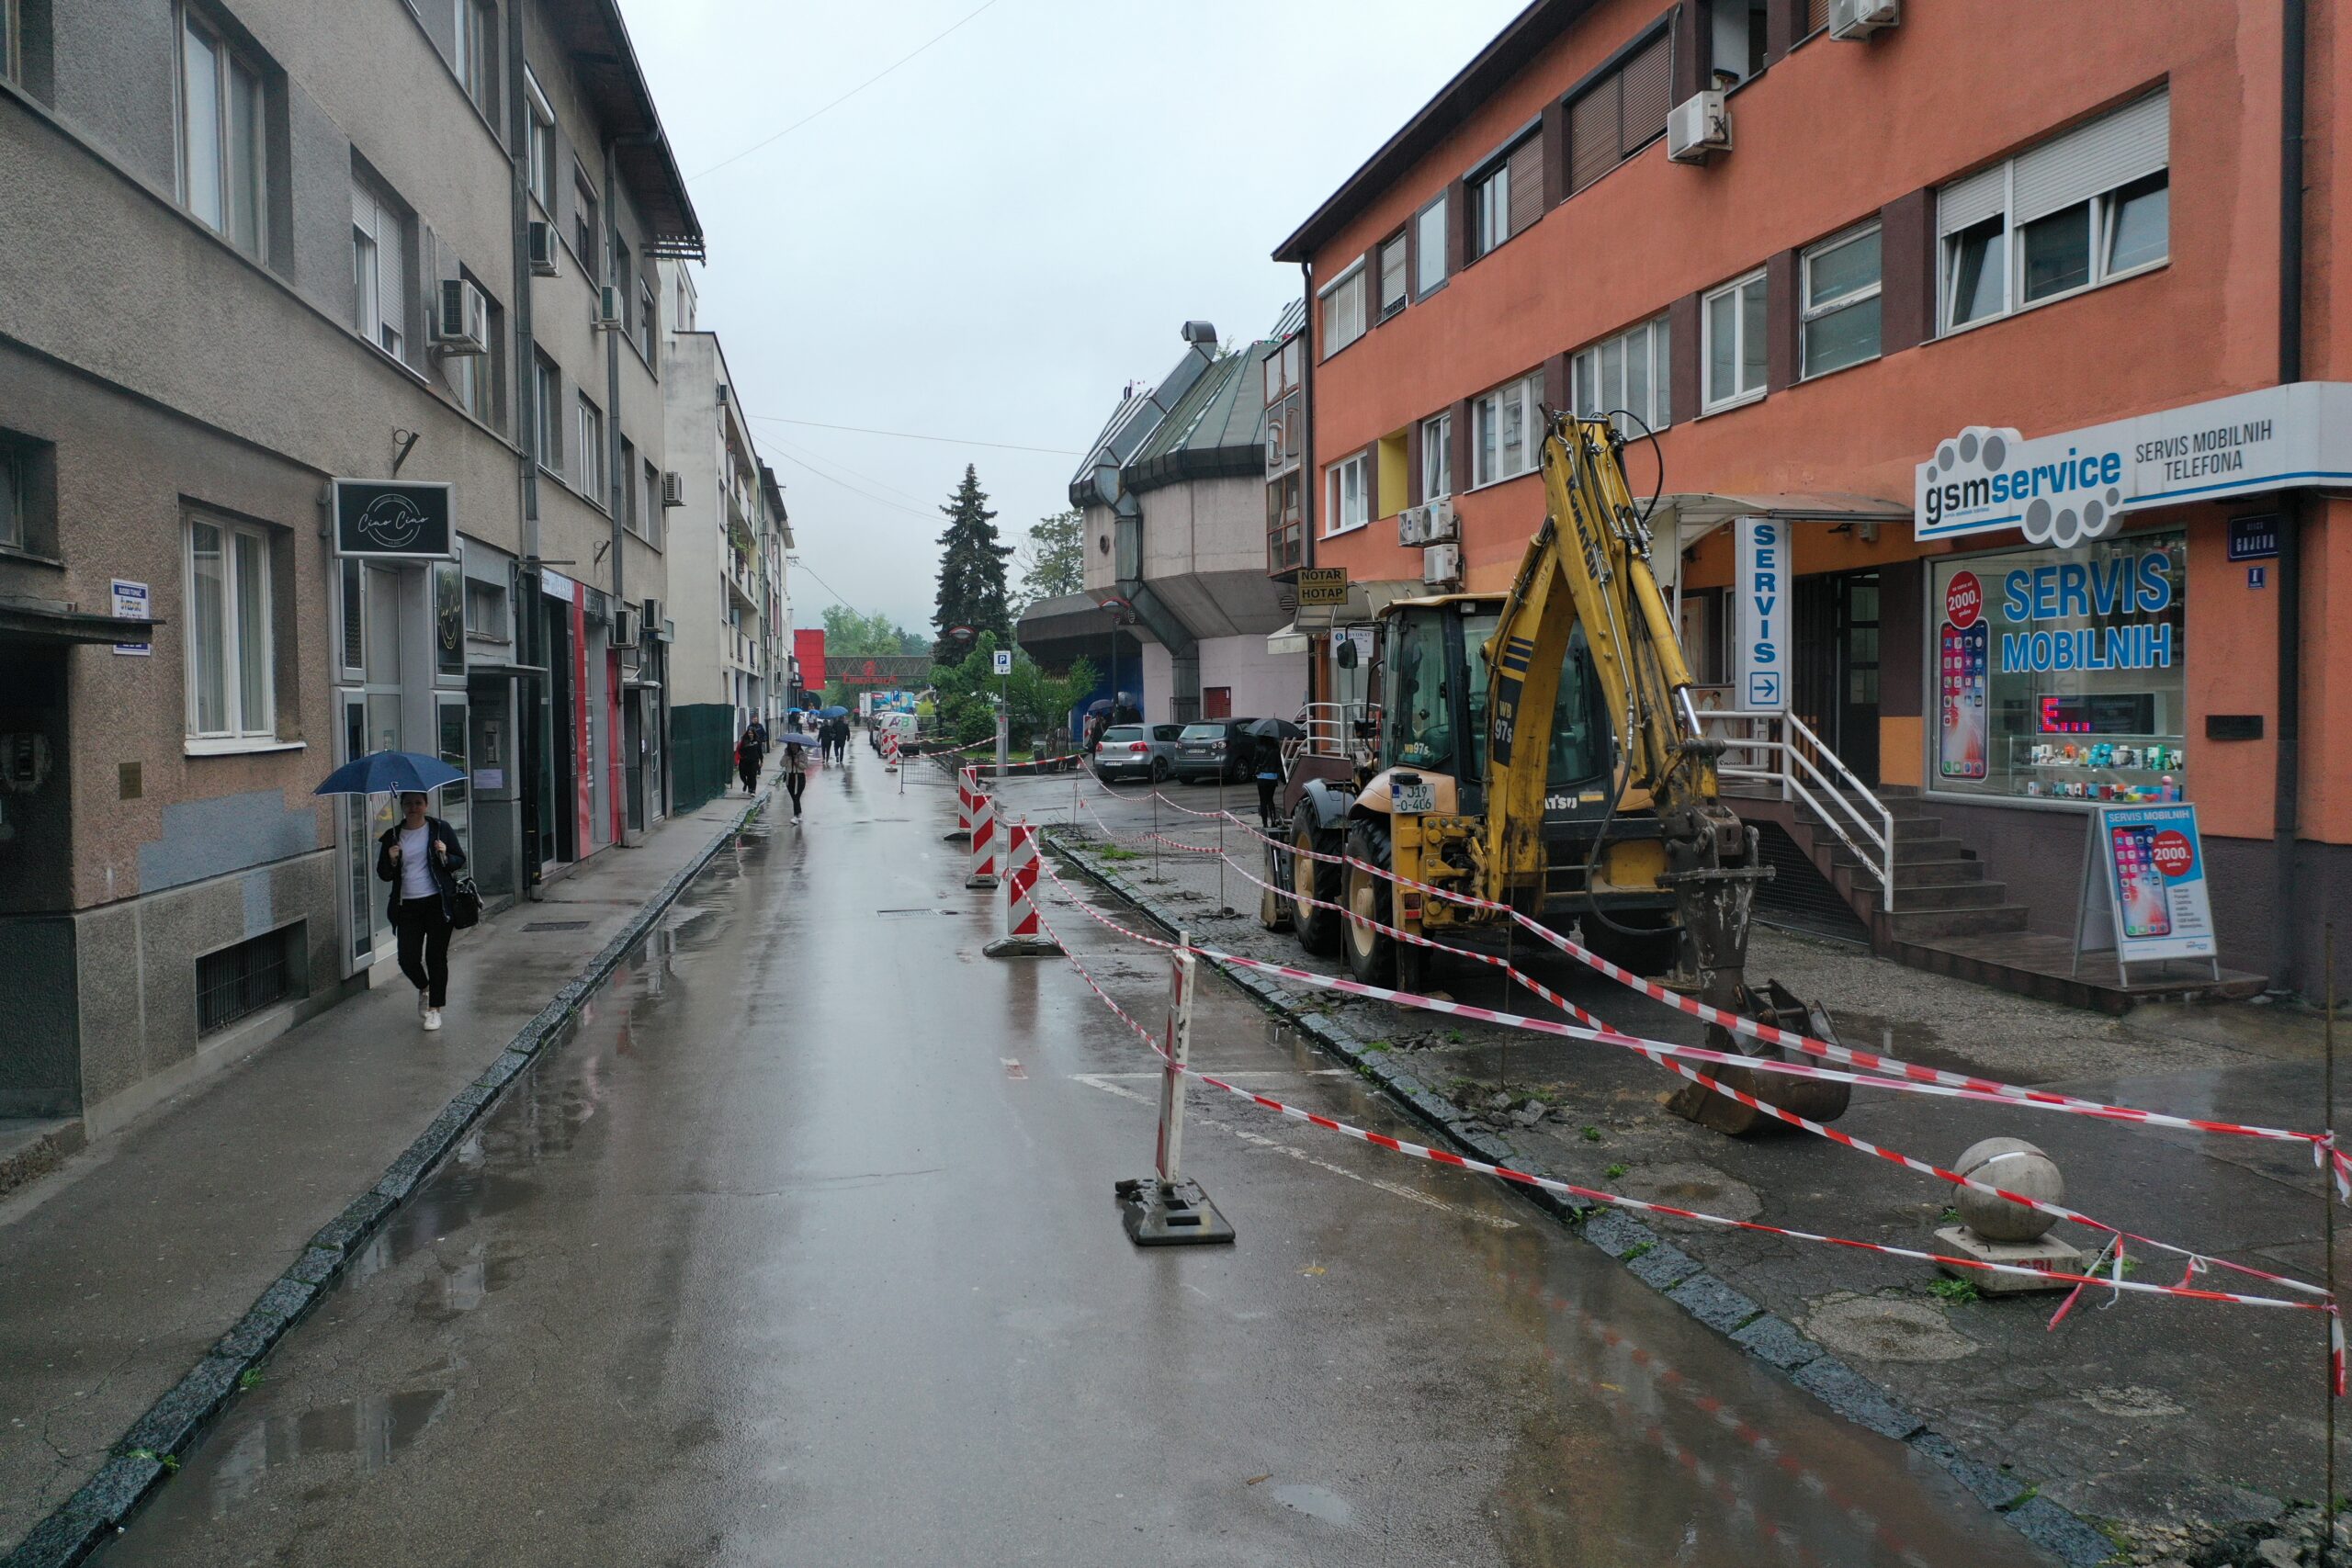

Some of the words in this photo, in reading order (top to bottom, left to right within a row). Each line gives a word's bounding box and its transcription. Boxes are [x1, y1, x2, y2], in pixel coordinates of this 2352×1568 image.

[2135, 435, 2188, 464] SERVIS
[2193, 419, 2272, 454] MOBILNIH
[2165, 450, 2243, 481] TELEFONA
[357, 513, 391, 533] Ciao
[396, 511, 429, 530] Ciao
[1301, 570, 1341, 581] NOTAR
[1754, 525, 1775, 663] SERVIS
[2003, 552, 2171, 623] SERVIS
[1948, 590, 1980, 612] 2000.
[2002, 623, 2171, 673] MOBILNIH
[1000, 656, 1006, 664] P
[1499, 700, 1512, 719] WB
[2109, 810, 2142, 823] SERVIS
[2143, 809, 2190, 821] MOBILNIH
[2154, 847, 2190, 861] 2000.
